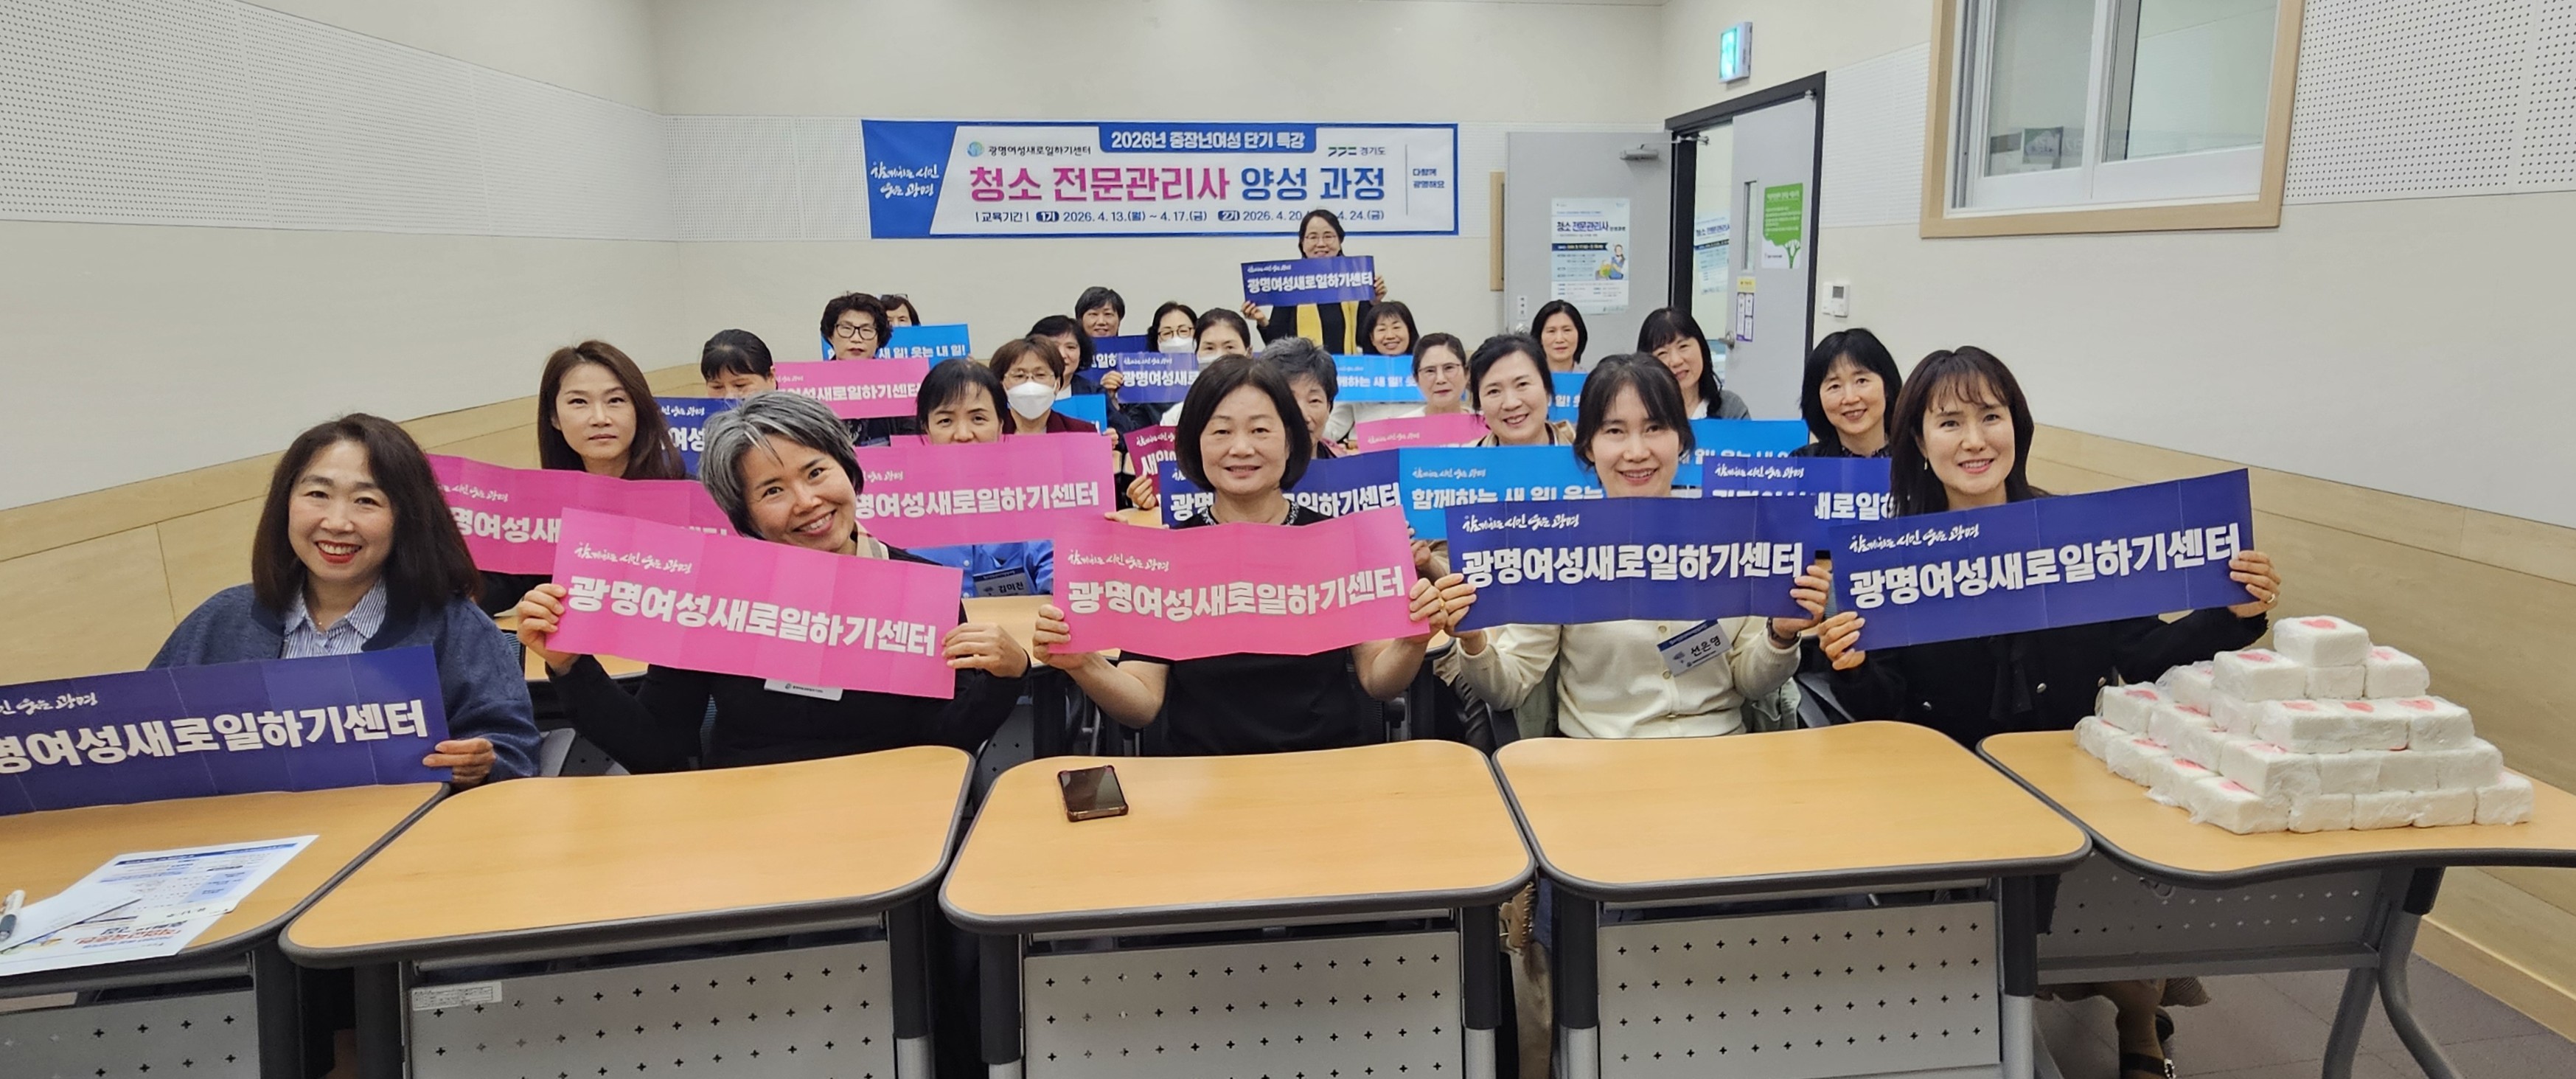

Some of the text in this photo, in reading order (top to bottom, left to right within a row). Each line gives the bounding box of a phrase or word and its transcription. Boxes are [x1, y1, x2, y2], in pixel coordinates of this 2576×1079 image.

[988, 145, 1091, 156] 광명여성새로일하기센터
[1112, 131, 1305, 149] 2026년 중장년여성 단기 특강
[1360, 147, 1386, 156] 경기도
[970, 167, 1385, 201] 청소 전문관리사 양성 과정
[981, 212, 1023, 222] 교육기간
[1040, 211, 1056, 221] 1기
[1247, 271, 1374, 294] 광명여성새로일하기센터
[894, 347, 908, 358] 일!
[911, 347, 934, 358] 웃는
[936, 345, 948, 357] 내
[950, 344, 966, 356] 일!
[1462, 513, 1579, 532] 함께하는 시민 웃는 광명
[1849, 524, 1980, 554] 함께하는 시민 웃는 광명
[1461, 542, 1803, 589] 광명여성새로일하기센터
[1849, 522, 2241, 609] 광명여성새로일하기센터
[1068, 566, 1406, 622] 광명여성새로일하기센터
[568, 575, 936, 657] 광명여성새로일하기센터
